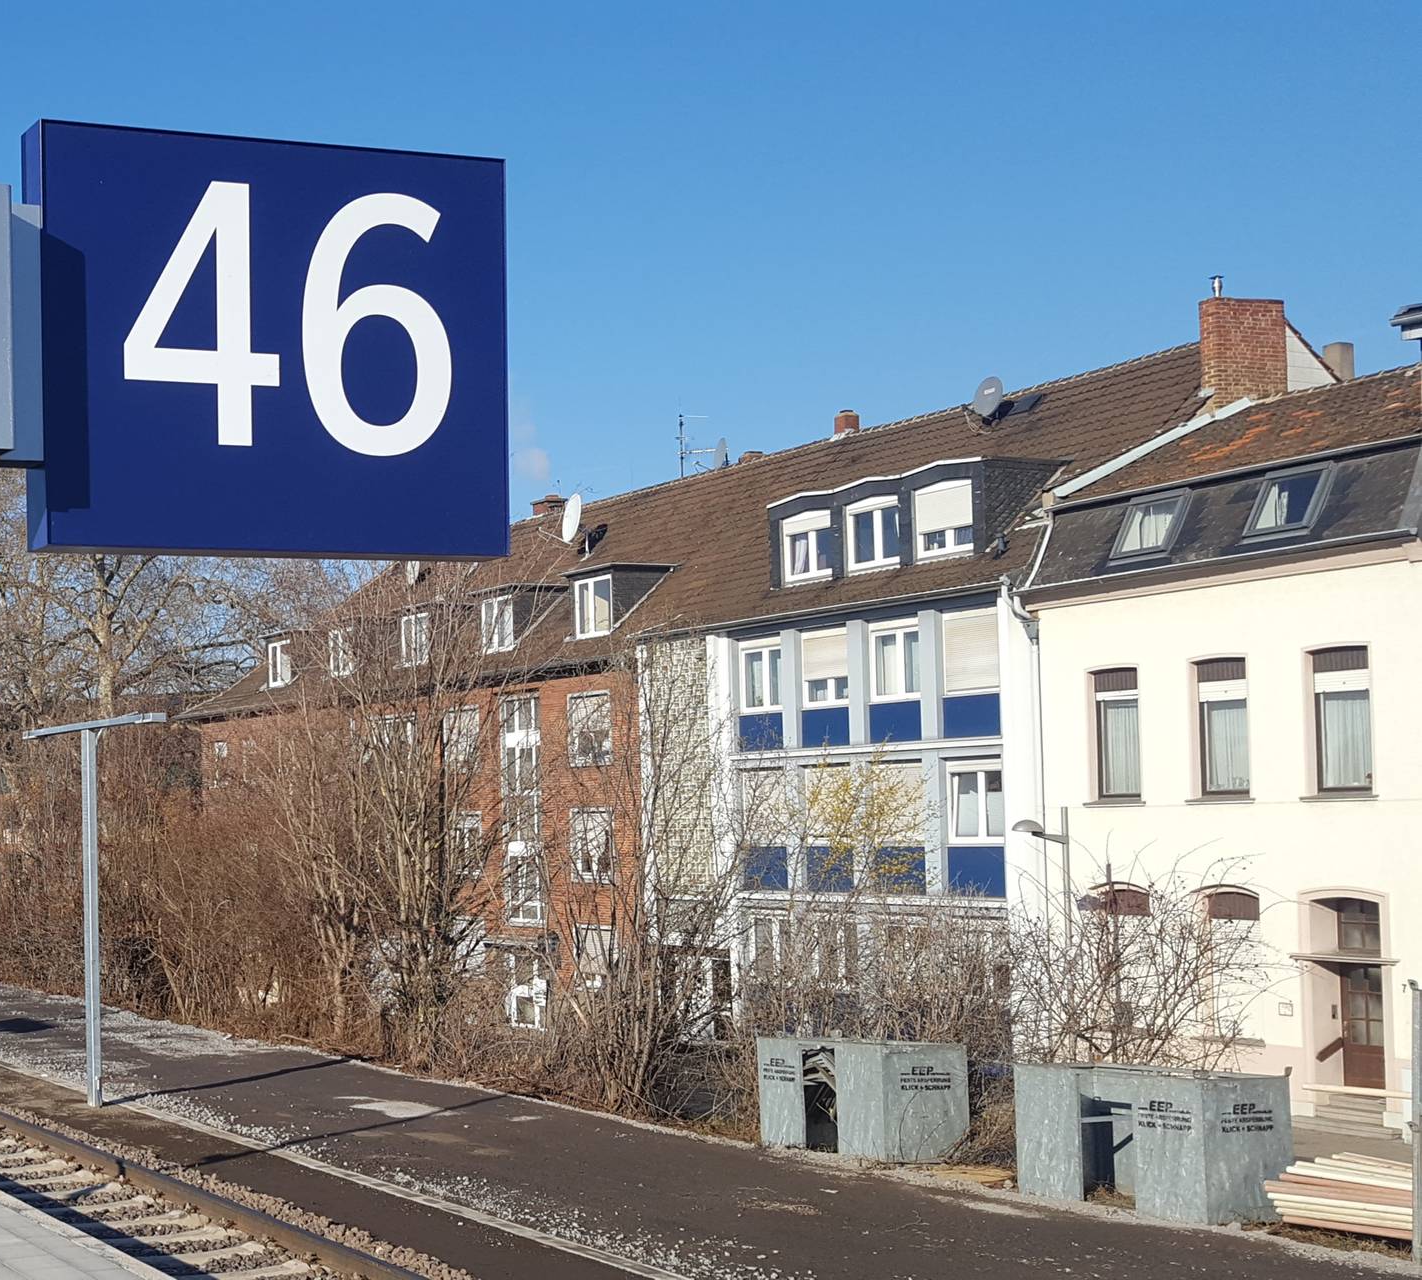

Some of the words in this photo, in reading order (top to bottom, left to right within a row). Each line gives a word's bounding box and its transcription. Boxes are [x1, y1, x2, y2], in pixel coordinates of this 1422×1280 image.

[123, 180, 453, 458] 46
[911, 1066, 934, 1076] EEP
[1149, 1100, 1173, 1112] EEP
[1233, 1103, 1255, 1115] EEP
